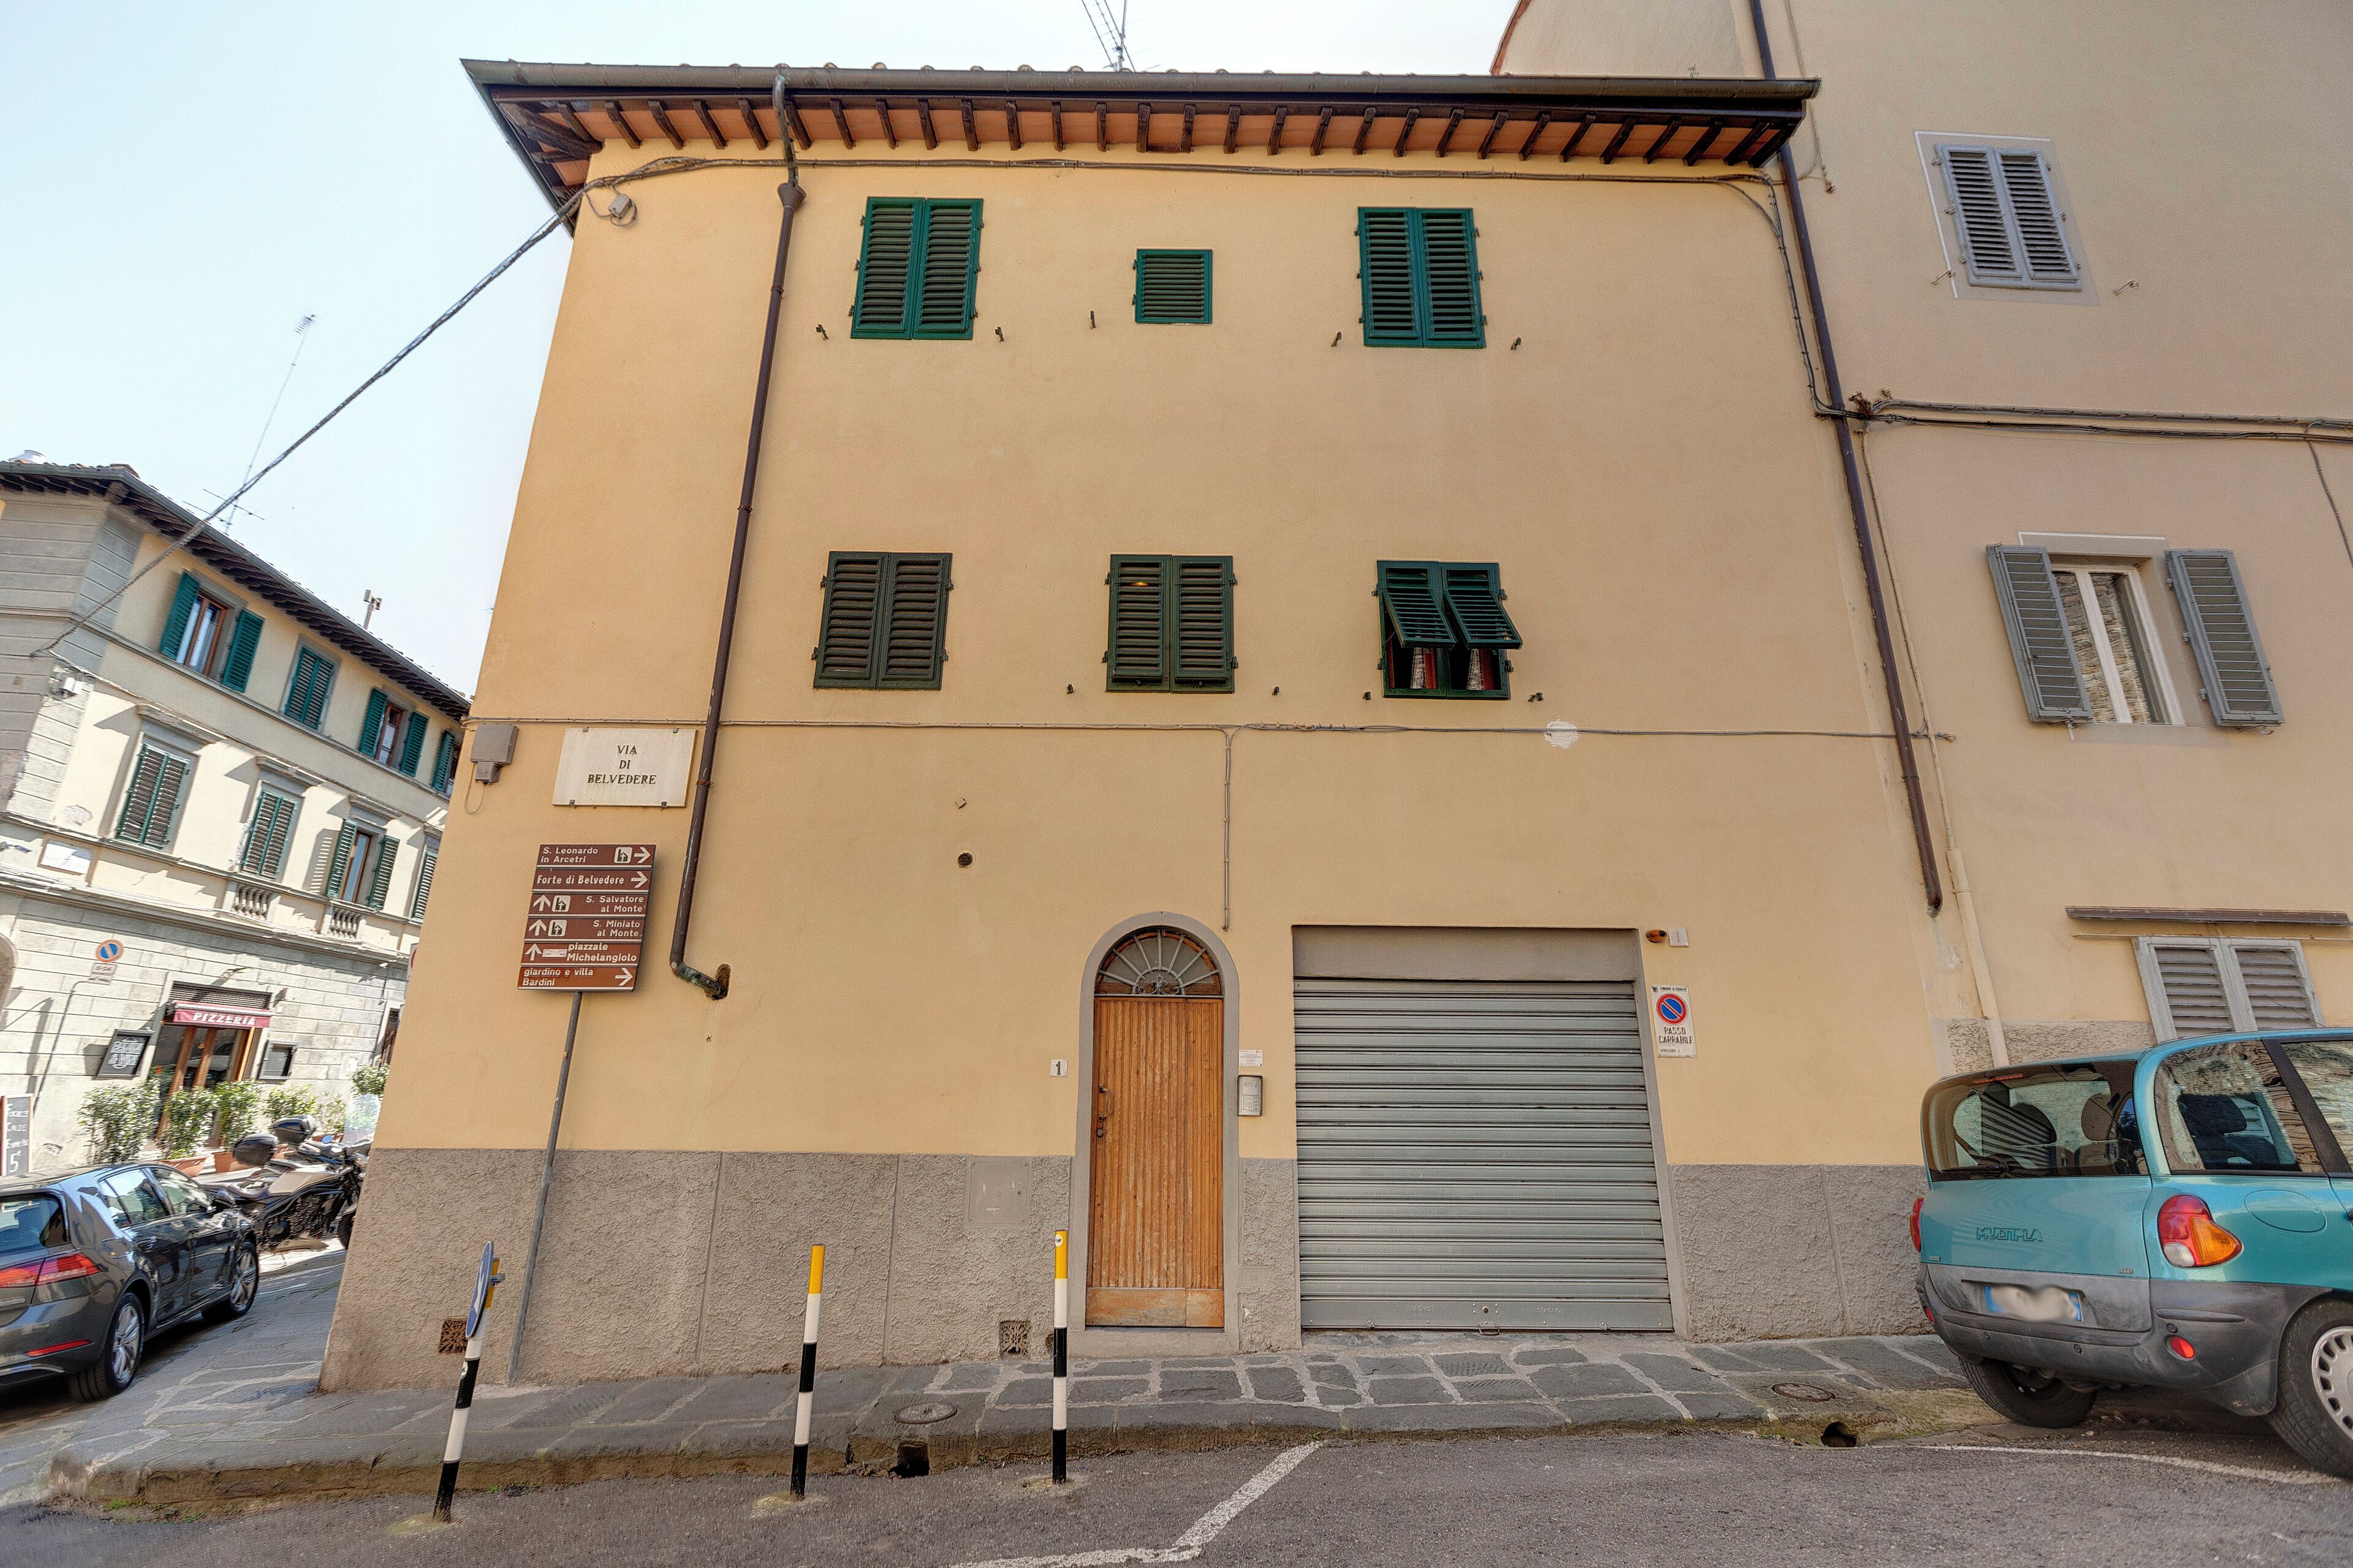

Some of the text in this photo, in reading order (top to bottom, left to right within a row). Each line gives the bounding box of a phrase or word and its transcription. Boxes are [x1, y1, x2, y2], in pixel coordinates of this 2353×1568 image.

[617, 745, 637, 754] VIA
[619, 760, 631, 769] DI
[587, 774, 657, 784] BELVEDERE
[537, 875, 624, 885] Forte di Belvedere
[567, 942, 608, 952] piazzale
[566, 953, 637, 963] Michelangiolo
[523, 968, 561, 977] giardino
[192, 1012, 256, 1026] PIZZERIA
[1055, 1061, 1061, 1075] 1
[1976, 1227, 2043, 1241] MULTIPLA
